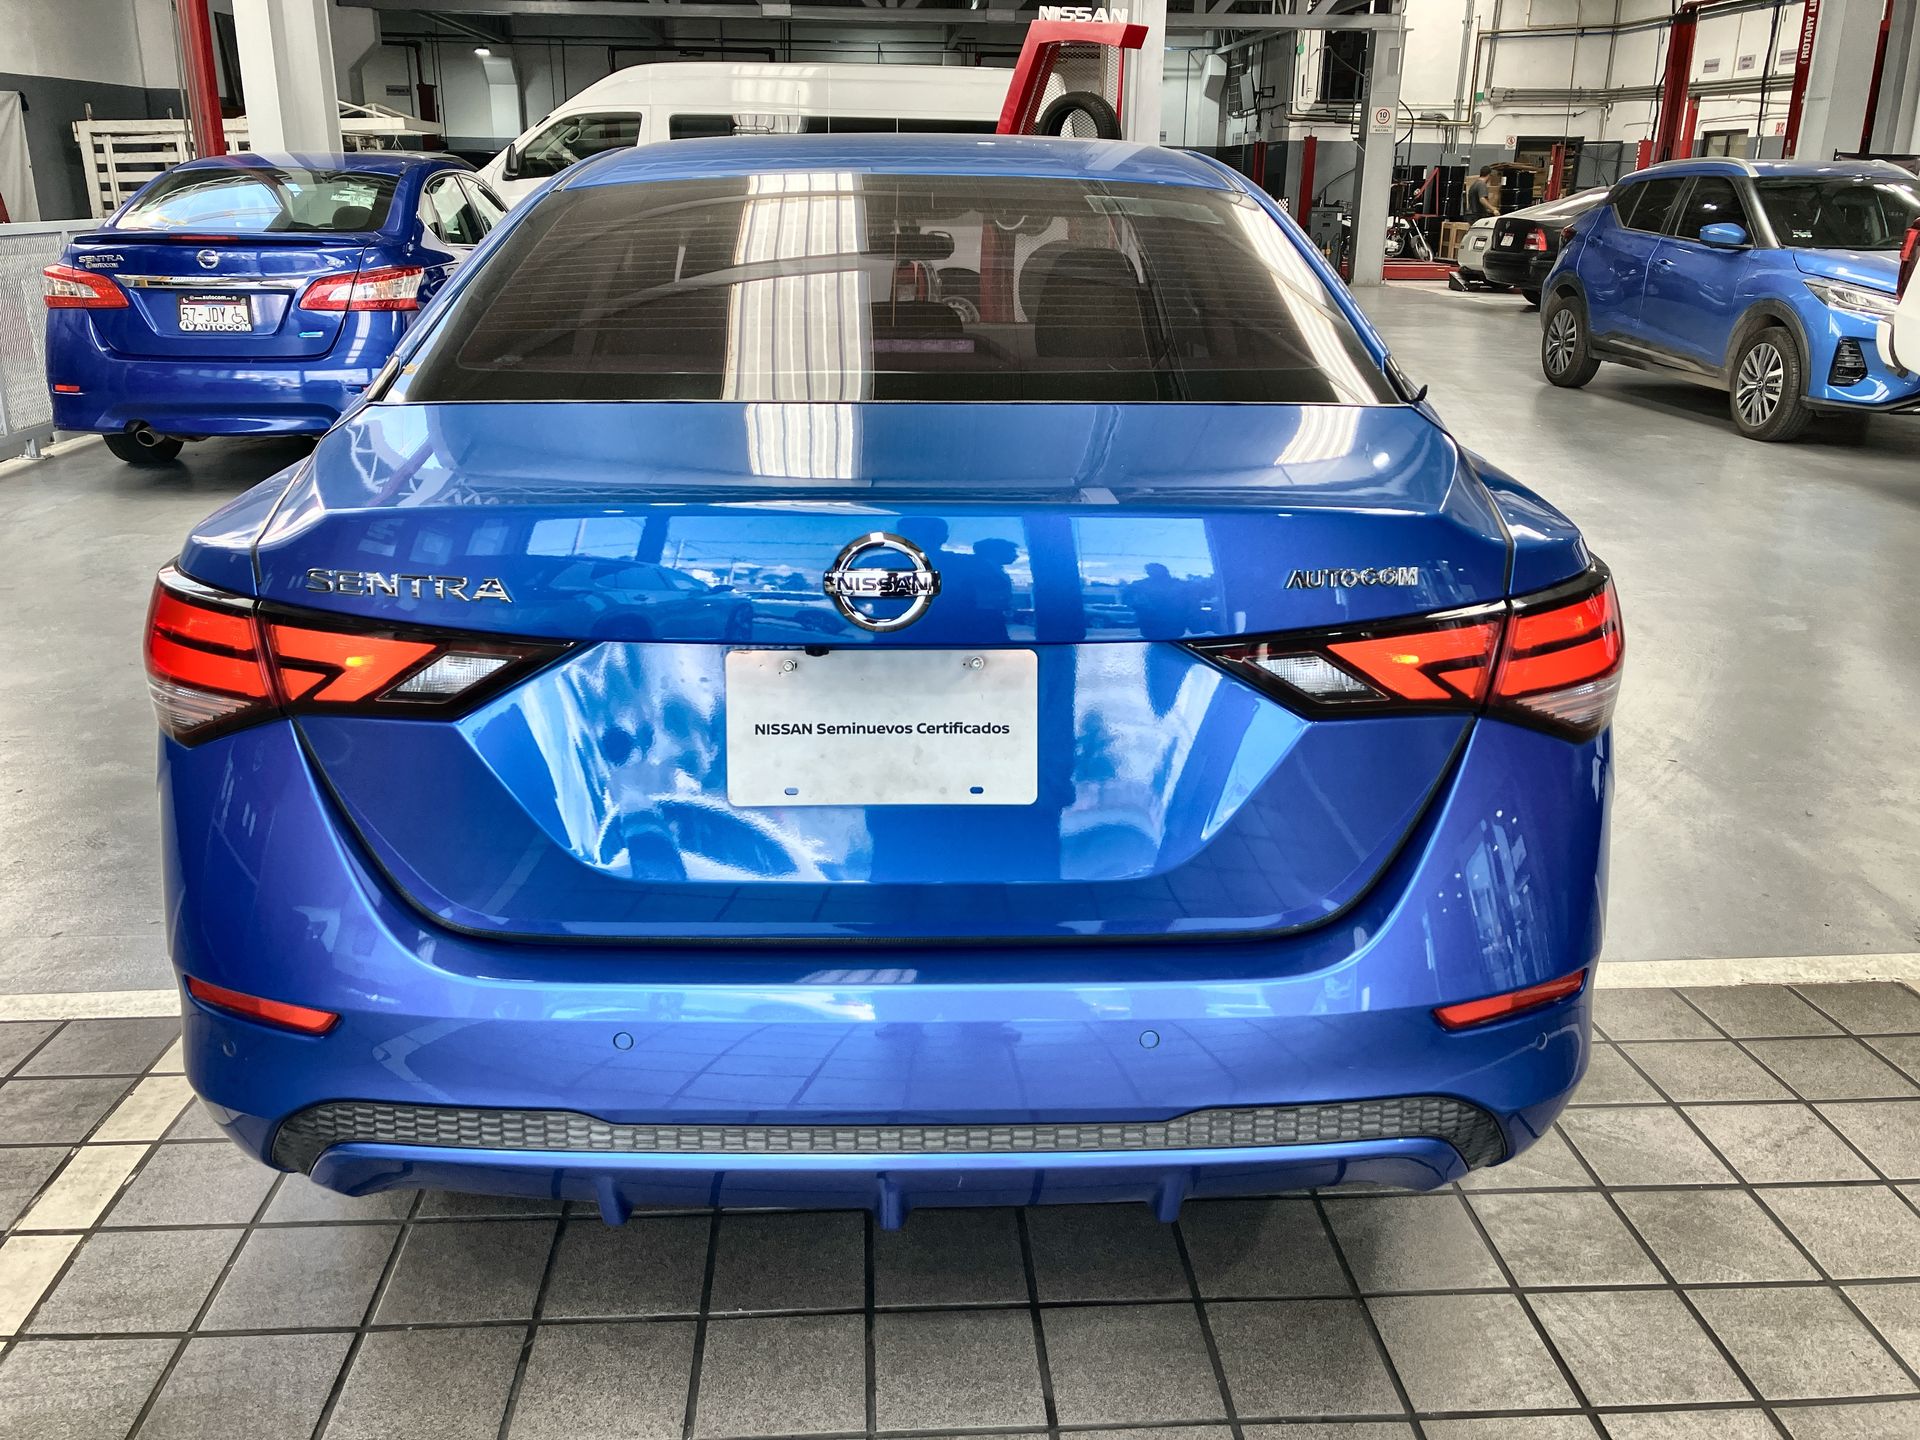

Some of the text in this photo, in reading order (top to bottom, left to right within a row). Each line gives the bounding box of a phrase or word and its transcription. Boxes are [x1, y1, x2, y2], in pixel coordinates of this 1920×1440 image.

[1038, 5, 1129, 23] NISSAN
[1801, 0, 1818, 59] ROTARY LI
[78, 254, 125, 263] SENTRA
[181, 307, 226, 323] 57-JDY
[195, 322, 252, 332] AUTOCOM
[305, 567, 513, 603] SENTRA
[836, 575, 933, 593] NISSAN
[1284, 565, 1419, 589] AUTOCOM
[754, 721, 1010, 736] NISSAN Seminuevos Certificados
